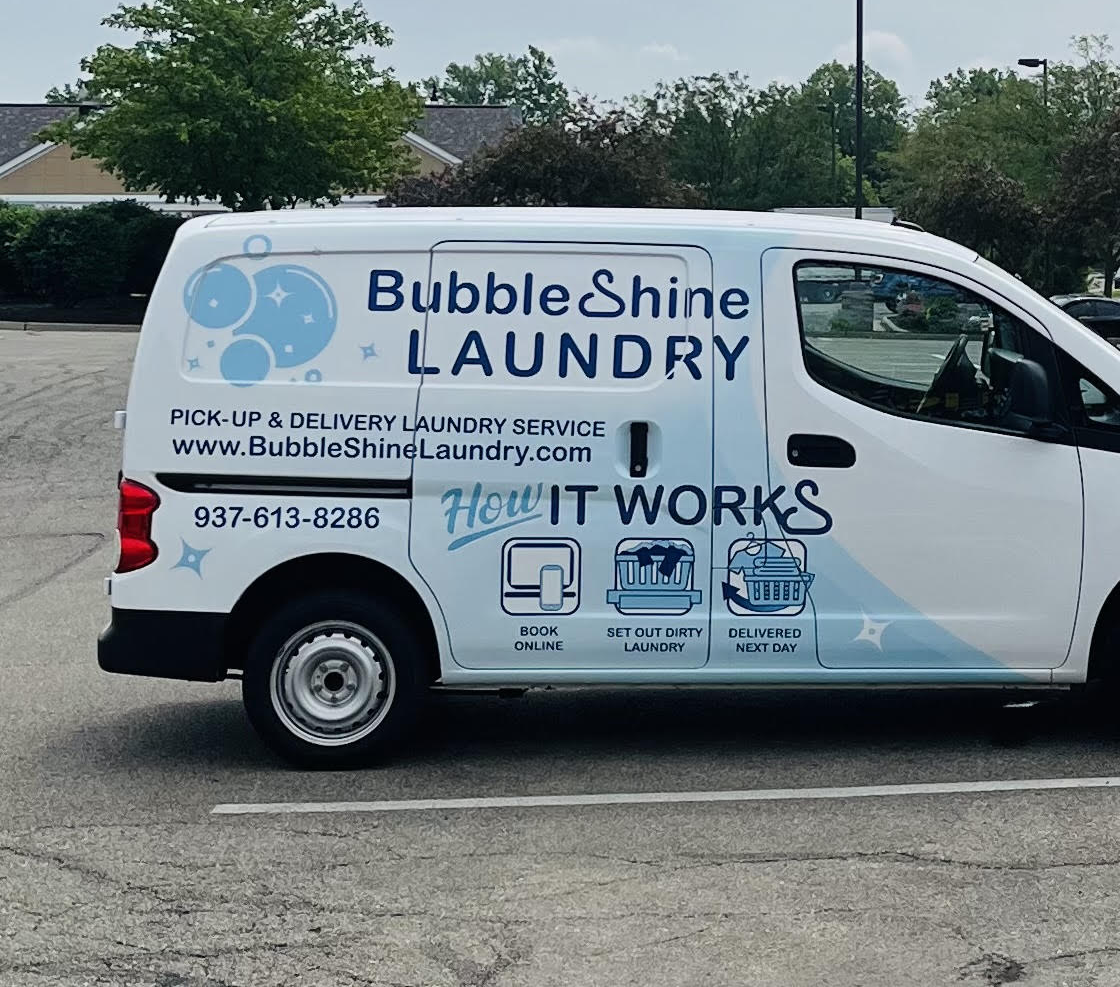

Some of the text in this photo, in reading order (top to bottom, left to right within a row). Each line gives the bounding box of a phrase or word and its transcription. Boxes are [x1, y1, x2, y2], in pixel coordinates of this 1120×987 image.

[367, 268, 750, 319] BubbleShine
[407, 328, 750, 381] LAUNDRY
[170, 408, 606, 438] PICK-UP & DELIVERY LAUNDRY SERVICE
[172, 435, 592, 466] www.BubbleShineLaundry.com
[441, 478, 833, 536] How IT WORKS
[194, 506, 380, 529] 937-613-8286
[520, 625, 559, 637] BOOK
[607, 627, 703, 638] SET OUT DIRTY
[728, 627, 802, 639] DELIVERED
[514, 640, 564, 652] ONLINE
[624, 642, 686, 653] LAUNDRY
[736, 642, 798, 653] NEXT DAY
